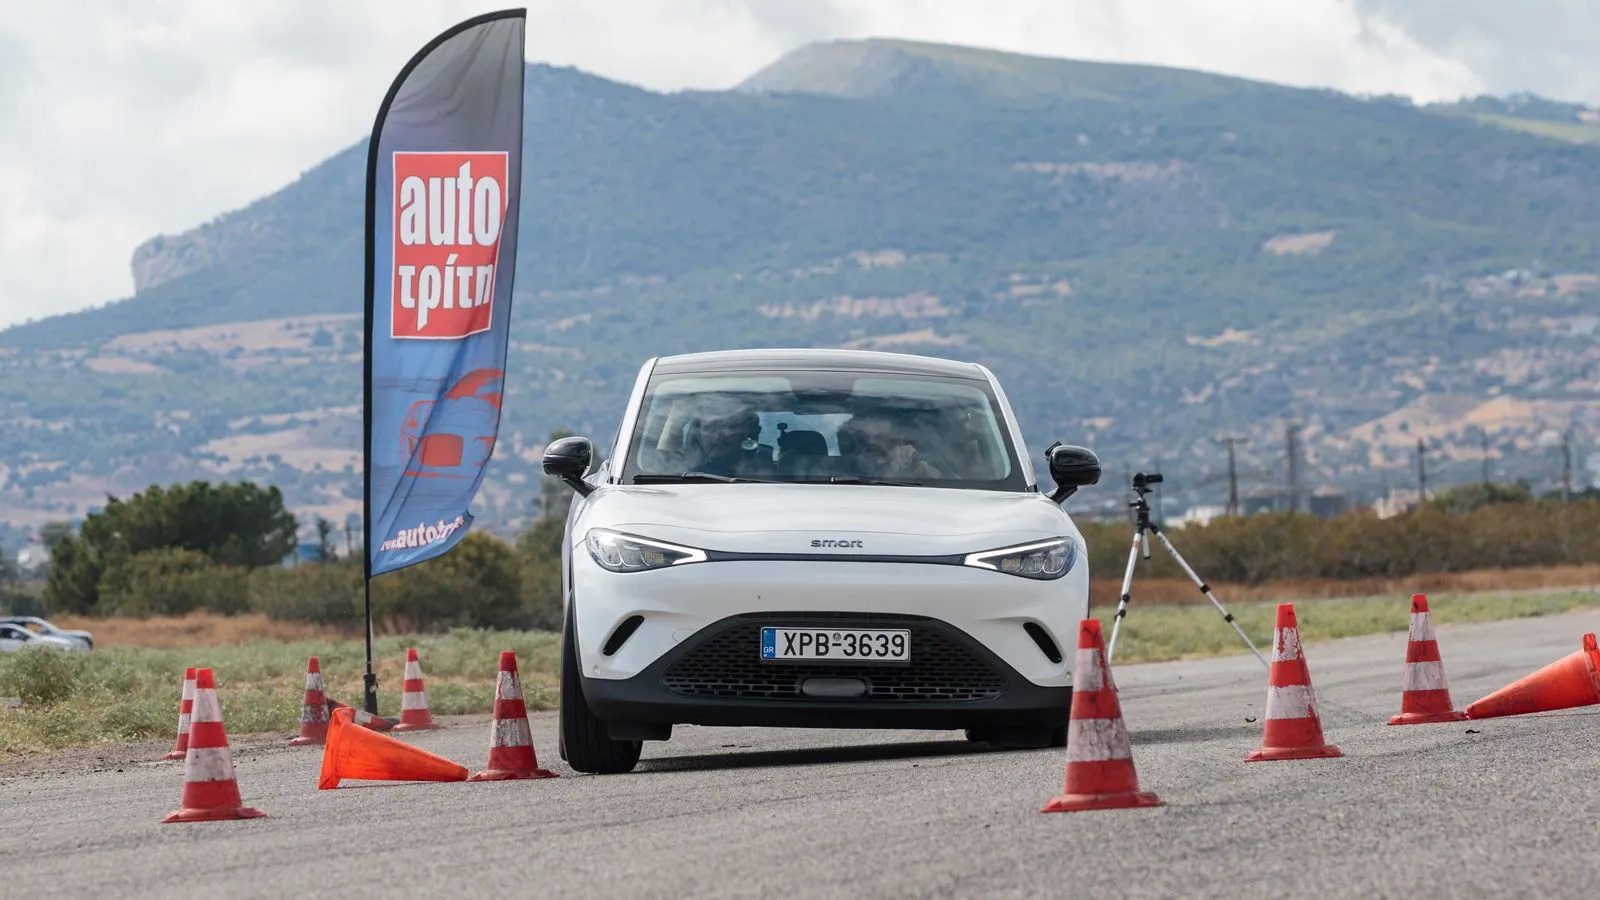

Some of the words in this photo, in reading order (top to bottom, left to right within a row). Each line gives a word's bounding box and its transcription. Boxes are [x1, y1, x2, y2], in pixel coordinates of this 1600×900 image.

[400, 160, 501, 246] auto
[810, 539, 863, 549] smart
[763, 646, 775, 654] GR
[783, 632, 905, 657] XPB-3639
